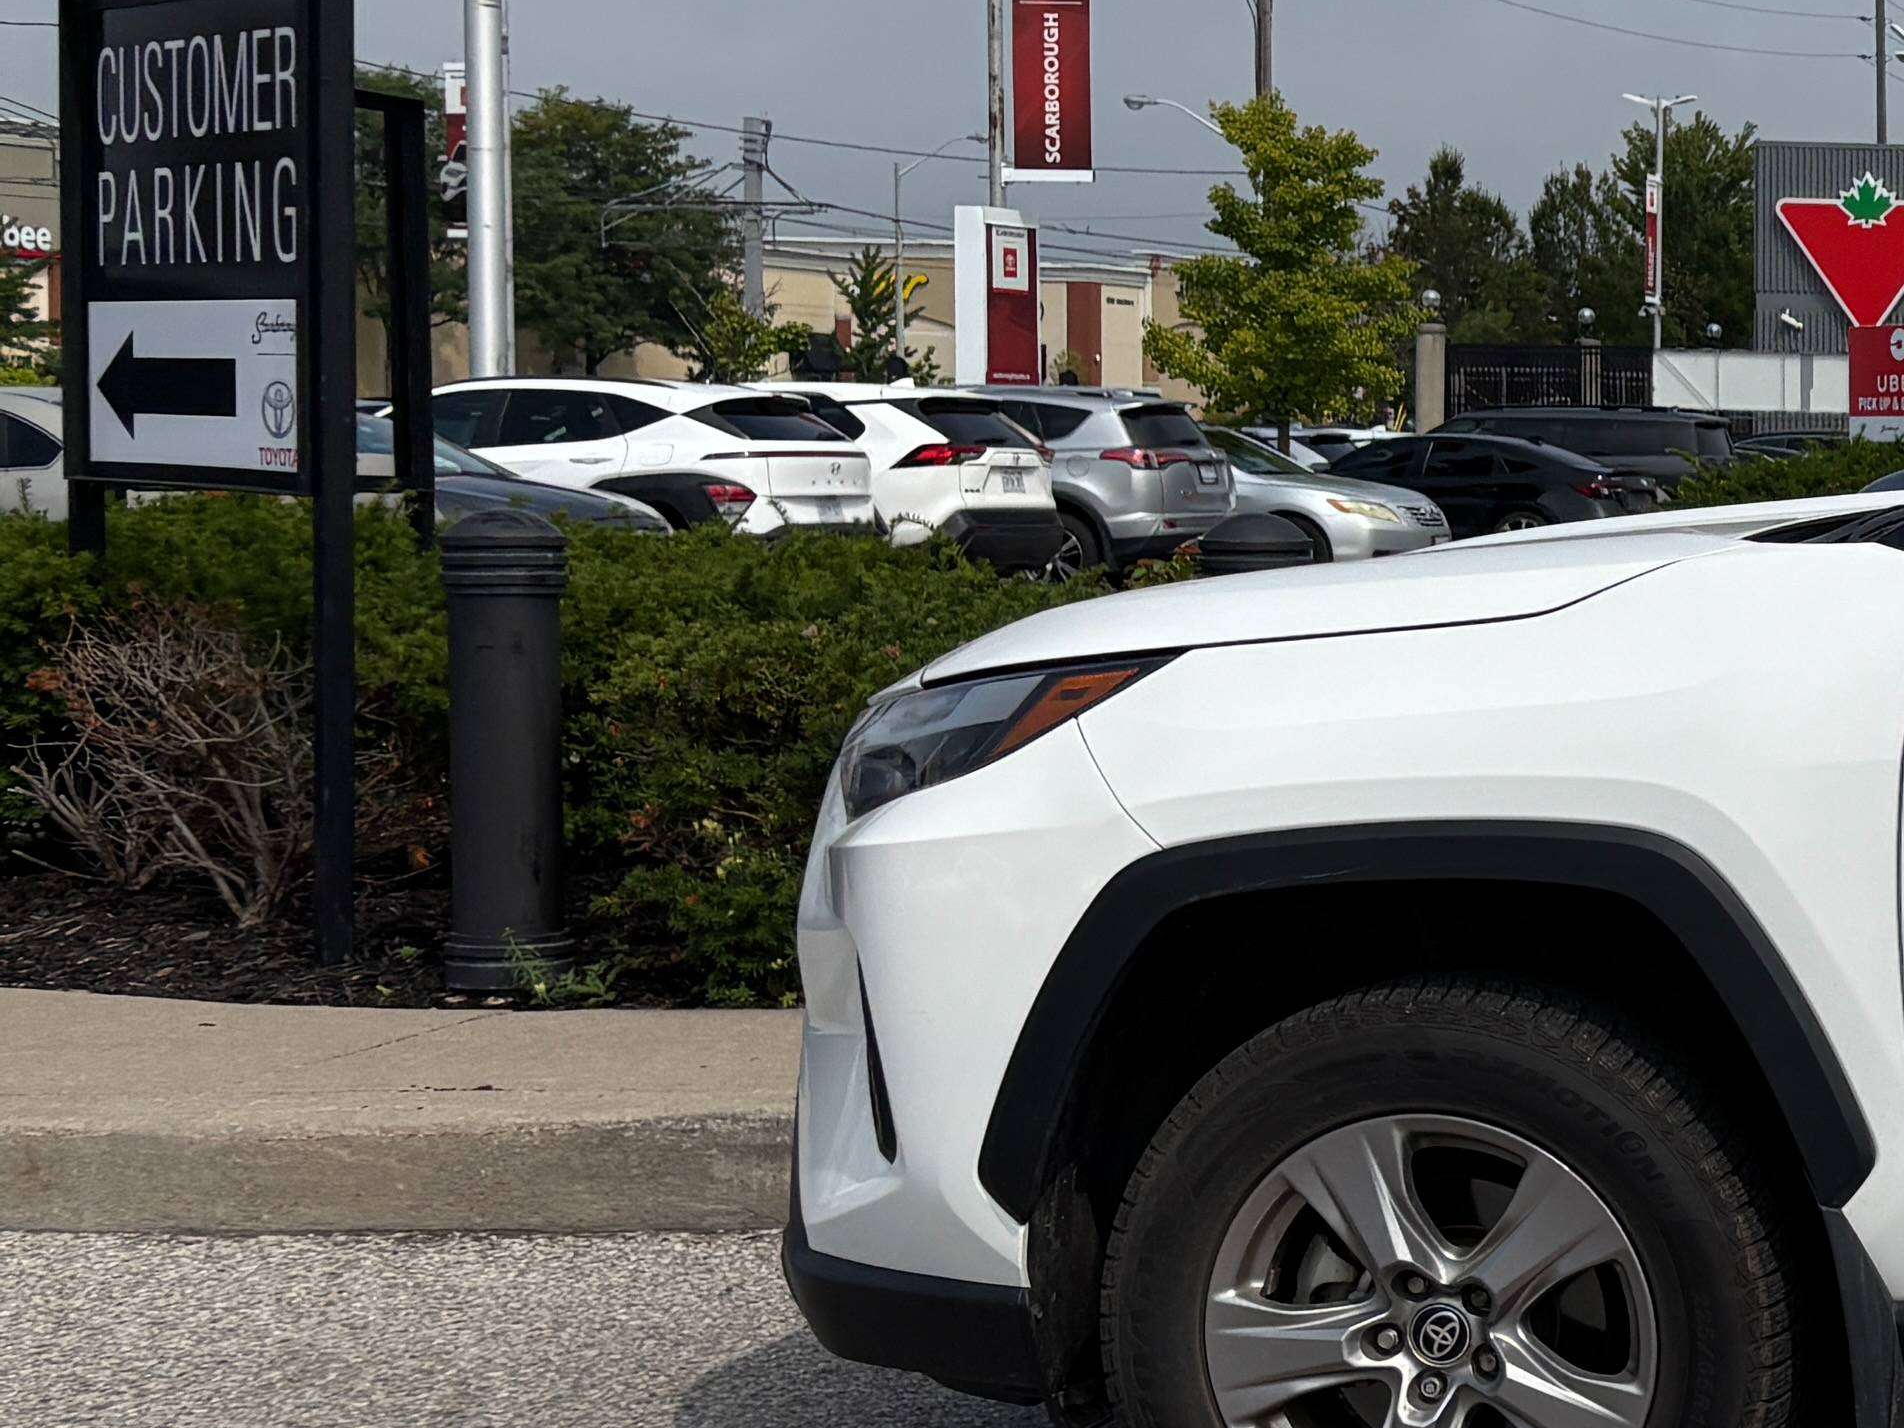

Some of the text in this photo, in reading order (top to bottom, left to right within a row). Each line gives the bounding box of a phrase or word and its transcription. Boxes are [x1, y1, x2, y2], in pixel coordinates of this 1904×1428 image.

[97, 25, 298, 145] CUSTOMER
[1043, 12, 1061, 164] SCARBOROUGH
[98, 157, 298, 267] PARKING
[258, 447, 299, 467] TOYOTA
[1858, 397, 1877, 411] PICK
[1879, 396, 1891, 411] UP
